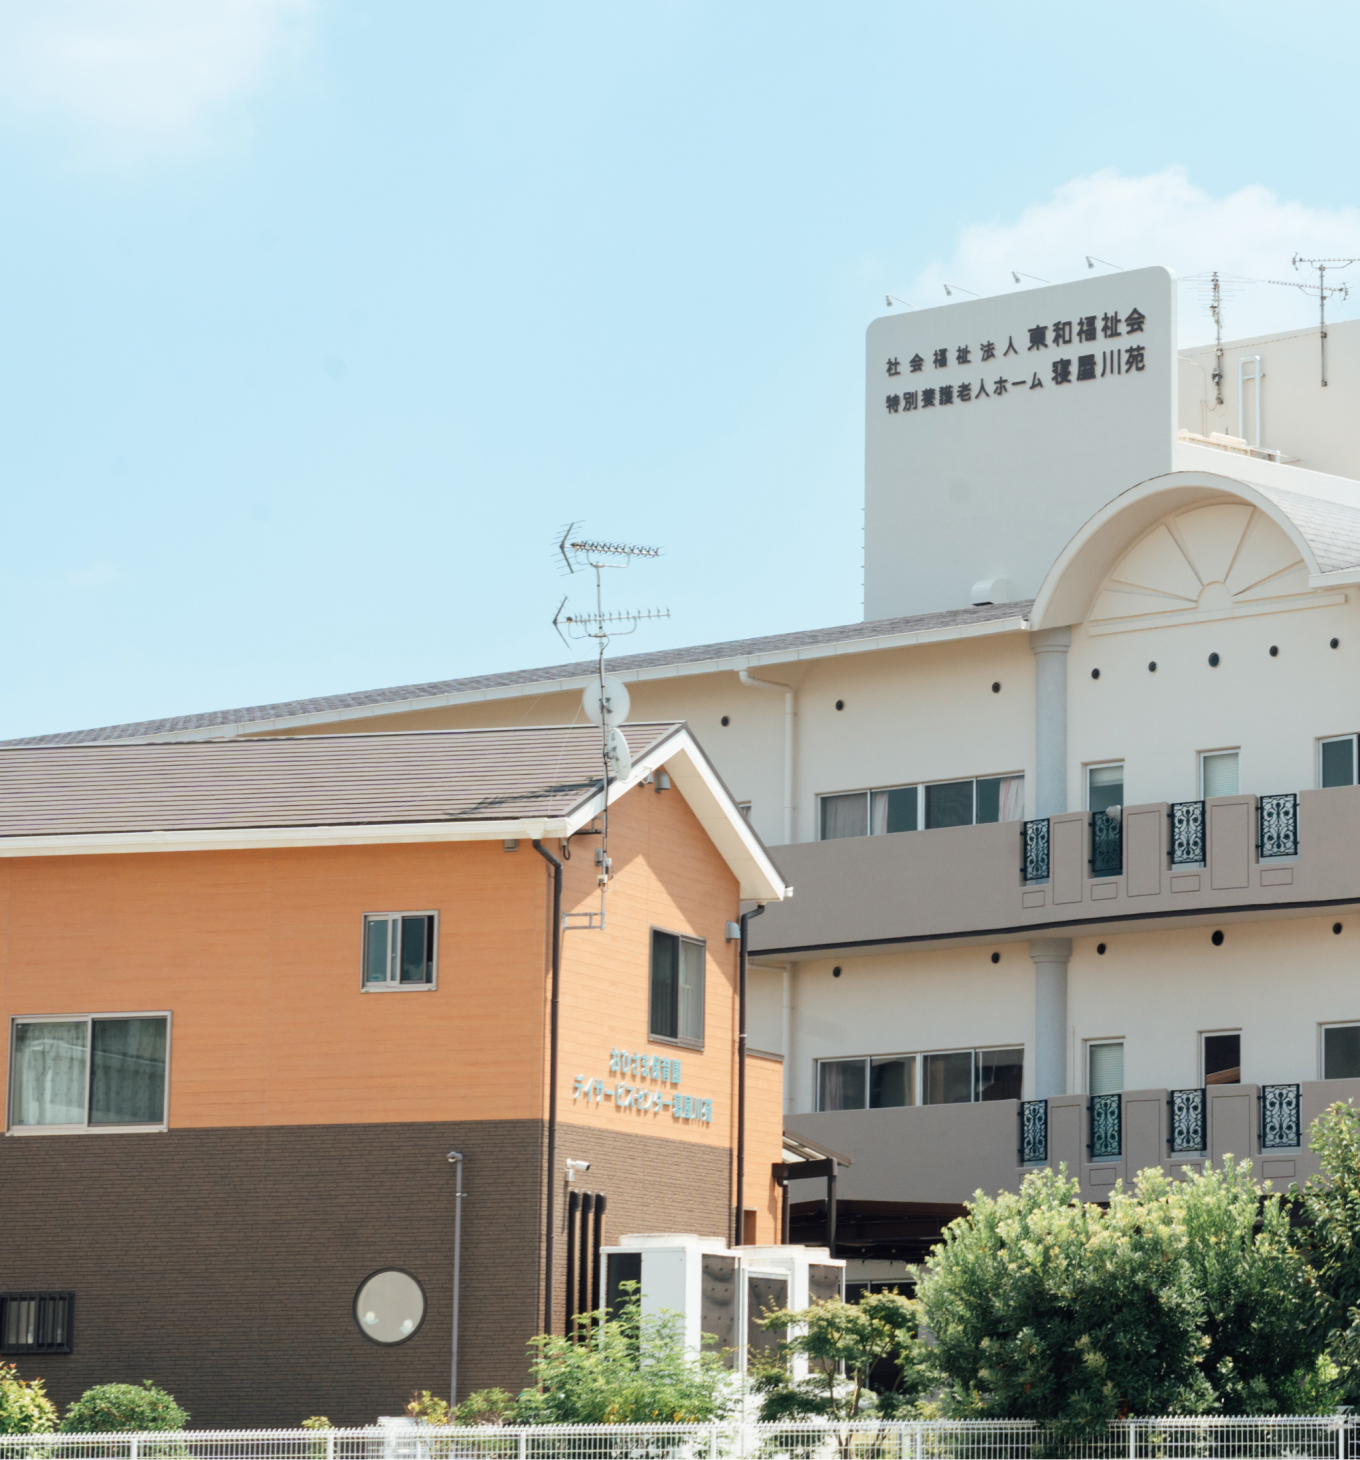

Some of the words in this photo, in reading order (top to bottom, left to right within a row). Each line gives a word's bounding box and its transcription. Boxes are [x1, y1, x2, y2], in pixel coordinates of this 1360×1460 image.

[885, 307, 1146, 378] 社会福祉法人東和福祉会
[610, 1047, 682, 1085] おひさま保育園
